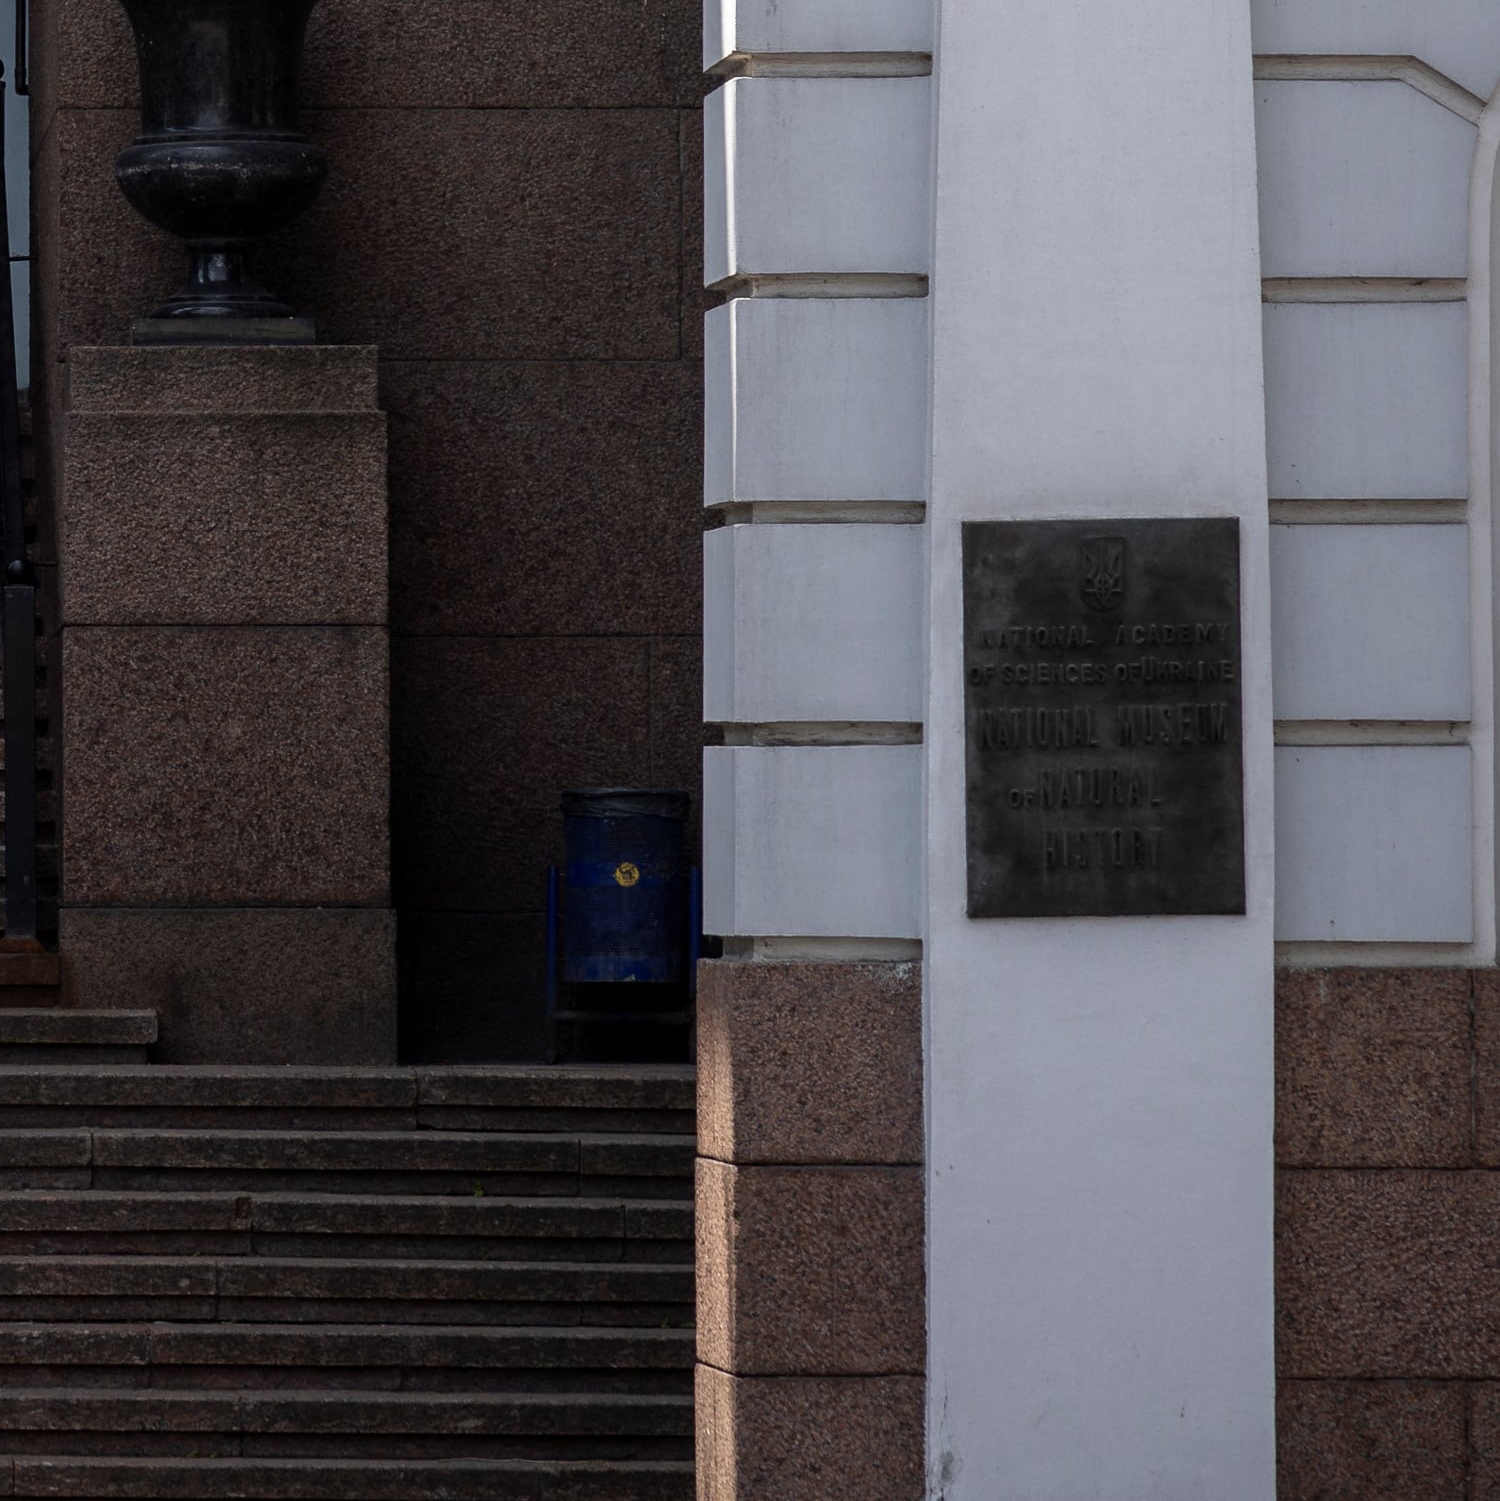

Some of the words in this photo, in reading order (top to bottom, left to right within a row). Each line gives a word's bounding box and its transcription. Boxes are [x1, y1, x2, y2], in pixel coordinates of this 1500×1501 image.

[979, 624, 1098, 650] NATIONAL
[1114, 622, 1233, 646] ACADEMY
[967, 662, 996, 687] OF
[999, 661, 1107, 685] SCIENCES
[1113, 661, 1141, 684] OF
[1141, 655, 1236, 684] UKRAINE
[976, 705, 1103, 750] NATIONAL
[1114, 702, 1230, 748] MUSEUM
[1007, 788, 1036, 809] OF
[1039, 765, 1163, 809] NATURAL
[1042, 827, 1164, 871] HISTORY
